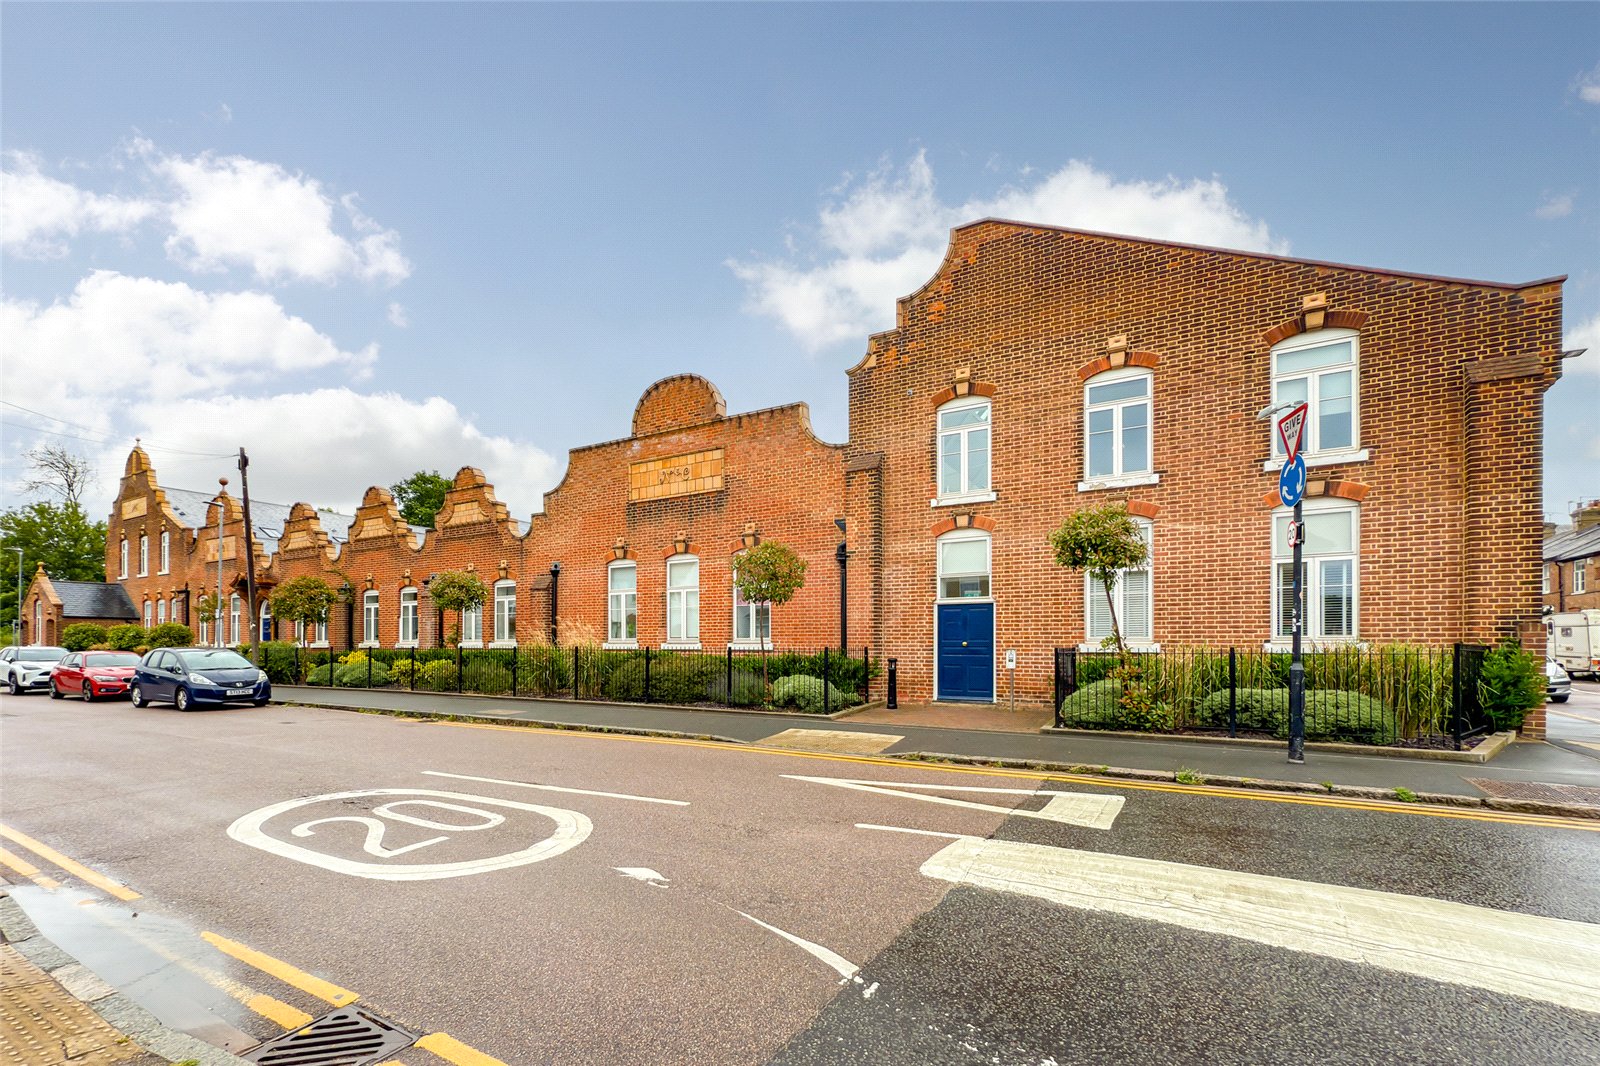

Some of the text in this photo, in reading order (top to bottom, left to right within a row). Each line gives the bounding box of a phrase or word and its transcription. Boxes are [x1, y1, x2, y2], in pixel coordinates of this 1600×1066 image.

[1283, 414, 1301, 433] GIVE
[1287, 429, 1298, 440] WAY
[291, 800, 506, 858] 20
